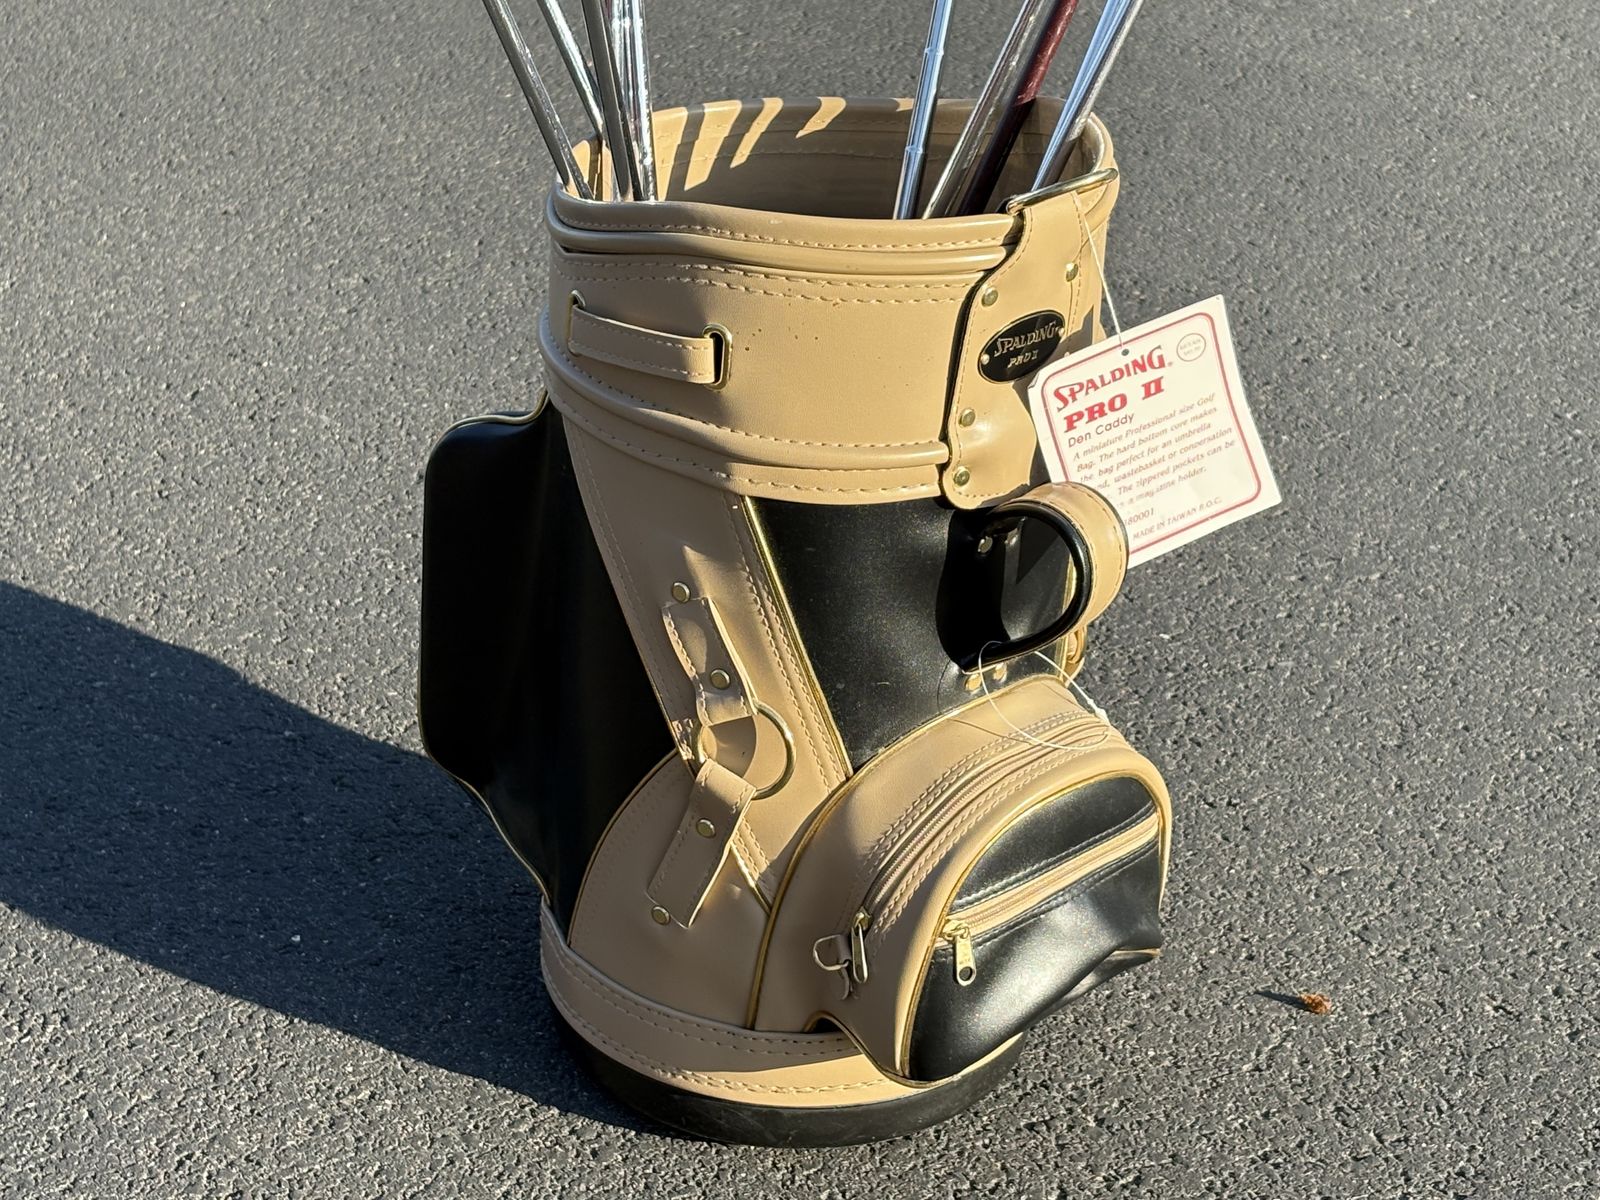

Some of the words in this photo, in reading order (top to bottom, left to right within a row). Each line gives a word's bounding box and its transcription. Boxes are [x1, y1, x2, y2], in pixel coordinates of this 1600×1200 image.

[994, 320, 1057, 358] SPALDING
[1007, 352, 1031, 368] PRO
[1053, 345, 1166, 413] SPALDING
[1064, 393, 1128, 433] PRO
[1141, 376, 1165, 400] II
[1068, 432, 1092, 448] Den
[1095, 413, 1135, 436] Caddy
[1083, 434, 1123, 457] miniature
[1125, 409, 1177, 438] Professional
[1197, 392, 1216, 406] Golf
[1098, 465, 1114, 477] bag
[1116, 450, 1145, 471] perfect
[1147, 445, 1159, 456] for
[1161, 439, 1173, 449] an
[1175, 423, 1212, 443] umbrella
[1099, 451, 1115, 463] The
[1116, 440, 1136, 455] hard
[1138, 428, 1168, 446] bottom
[1190, 407, 1217, 423] makes
[1114, 455, 1166, 483] wastebasket
[1168, 451, 1177, 460] or
[1179, 427, 1233, 455] conversation
[1118, 484, 1133, 495] The
[1136, 466, 1171, 487] zippered
[1172, 453, 1205, 473] pockets
[1206, 445, 1222, 457] can
[1132, 525, 1156, 541] MADE
[1157, 519, 1166, 531] IN
[1167, 507, 1197, 525] TAIWAN
